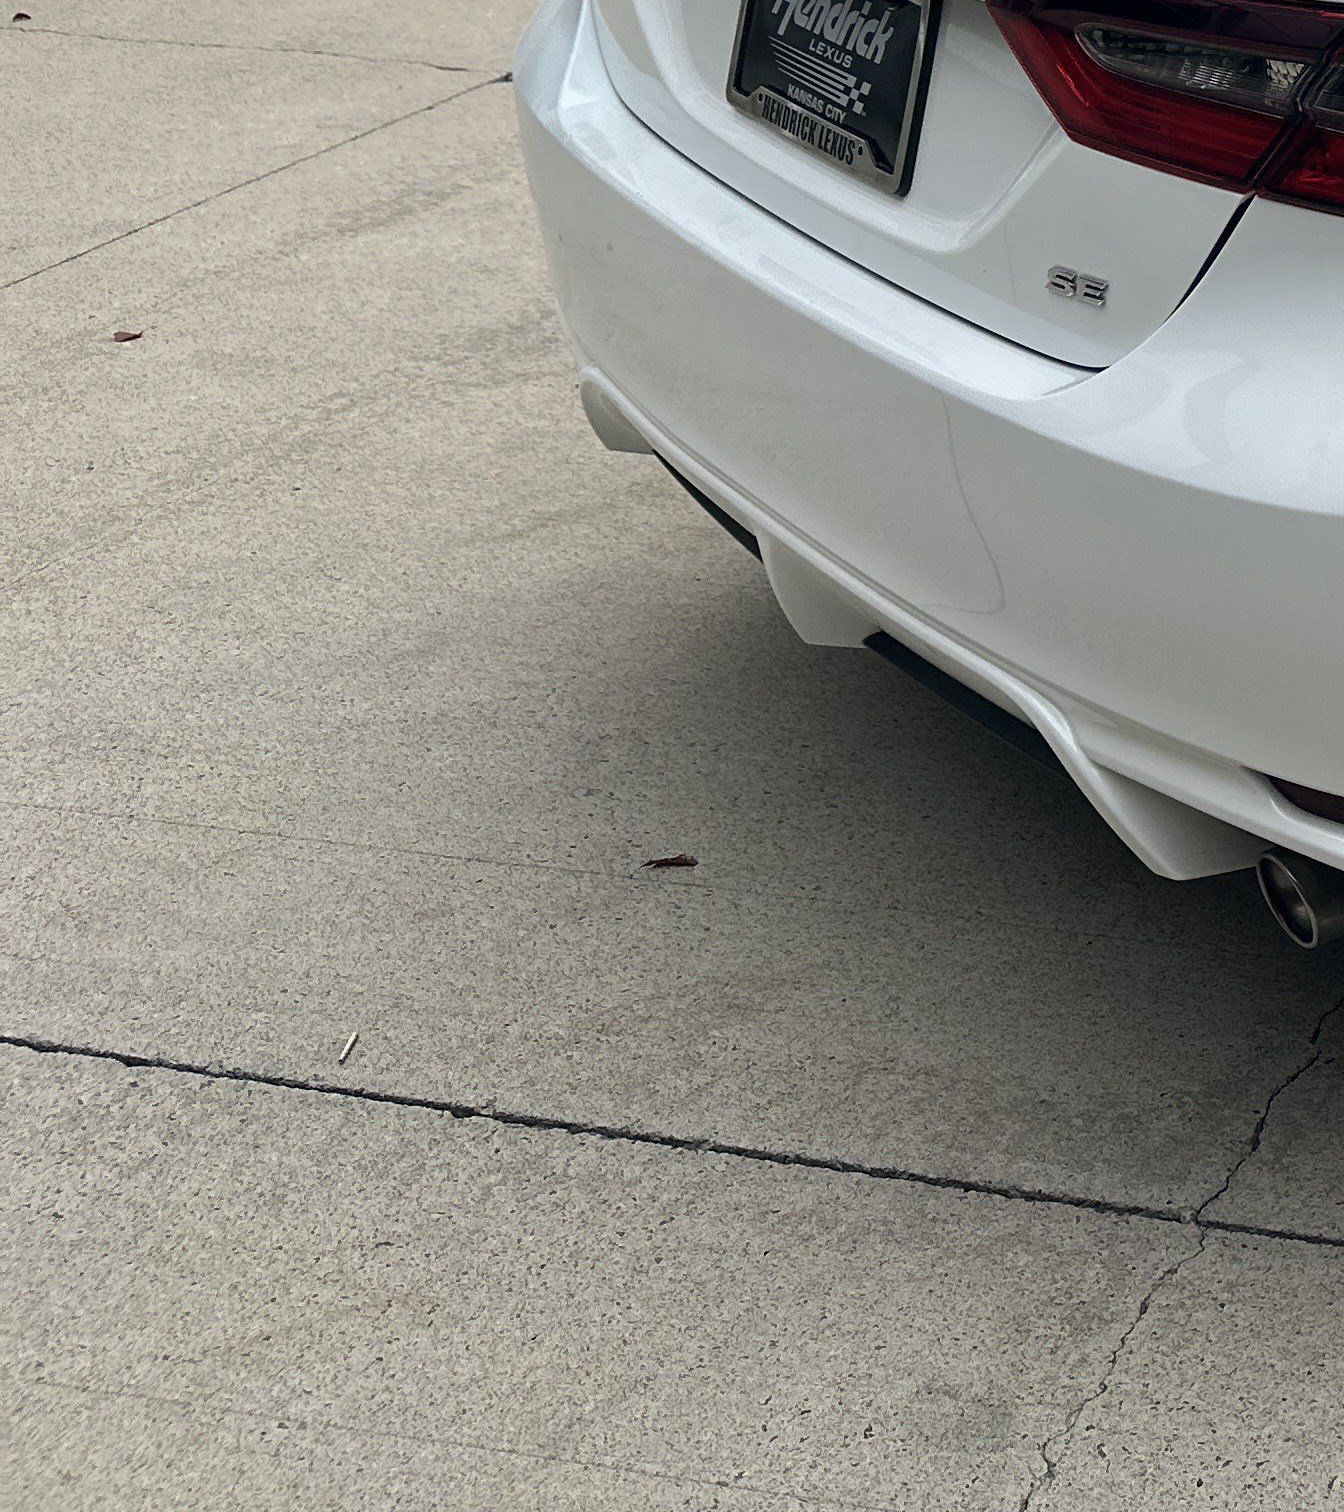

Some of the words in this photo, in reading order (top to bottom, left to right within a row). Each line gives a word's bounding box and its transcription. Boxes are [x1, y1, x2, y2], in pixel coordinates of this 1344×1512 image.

[809, 38, 853, 69] LEXUS
[787, 84, 824, 112] KANSAS
[823, 104, 847, 125] CITY
[762, 97, 819, 147] HENDRICK
[819, 126, 856, 165] LEXUS
[1045, 265, 1109, 309] SE
